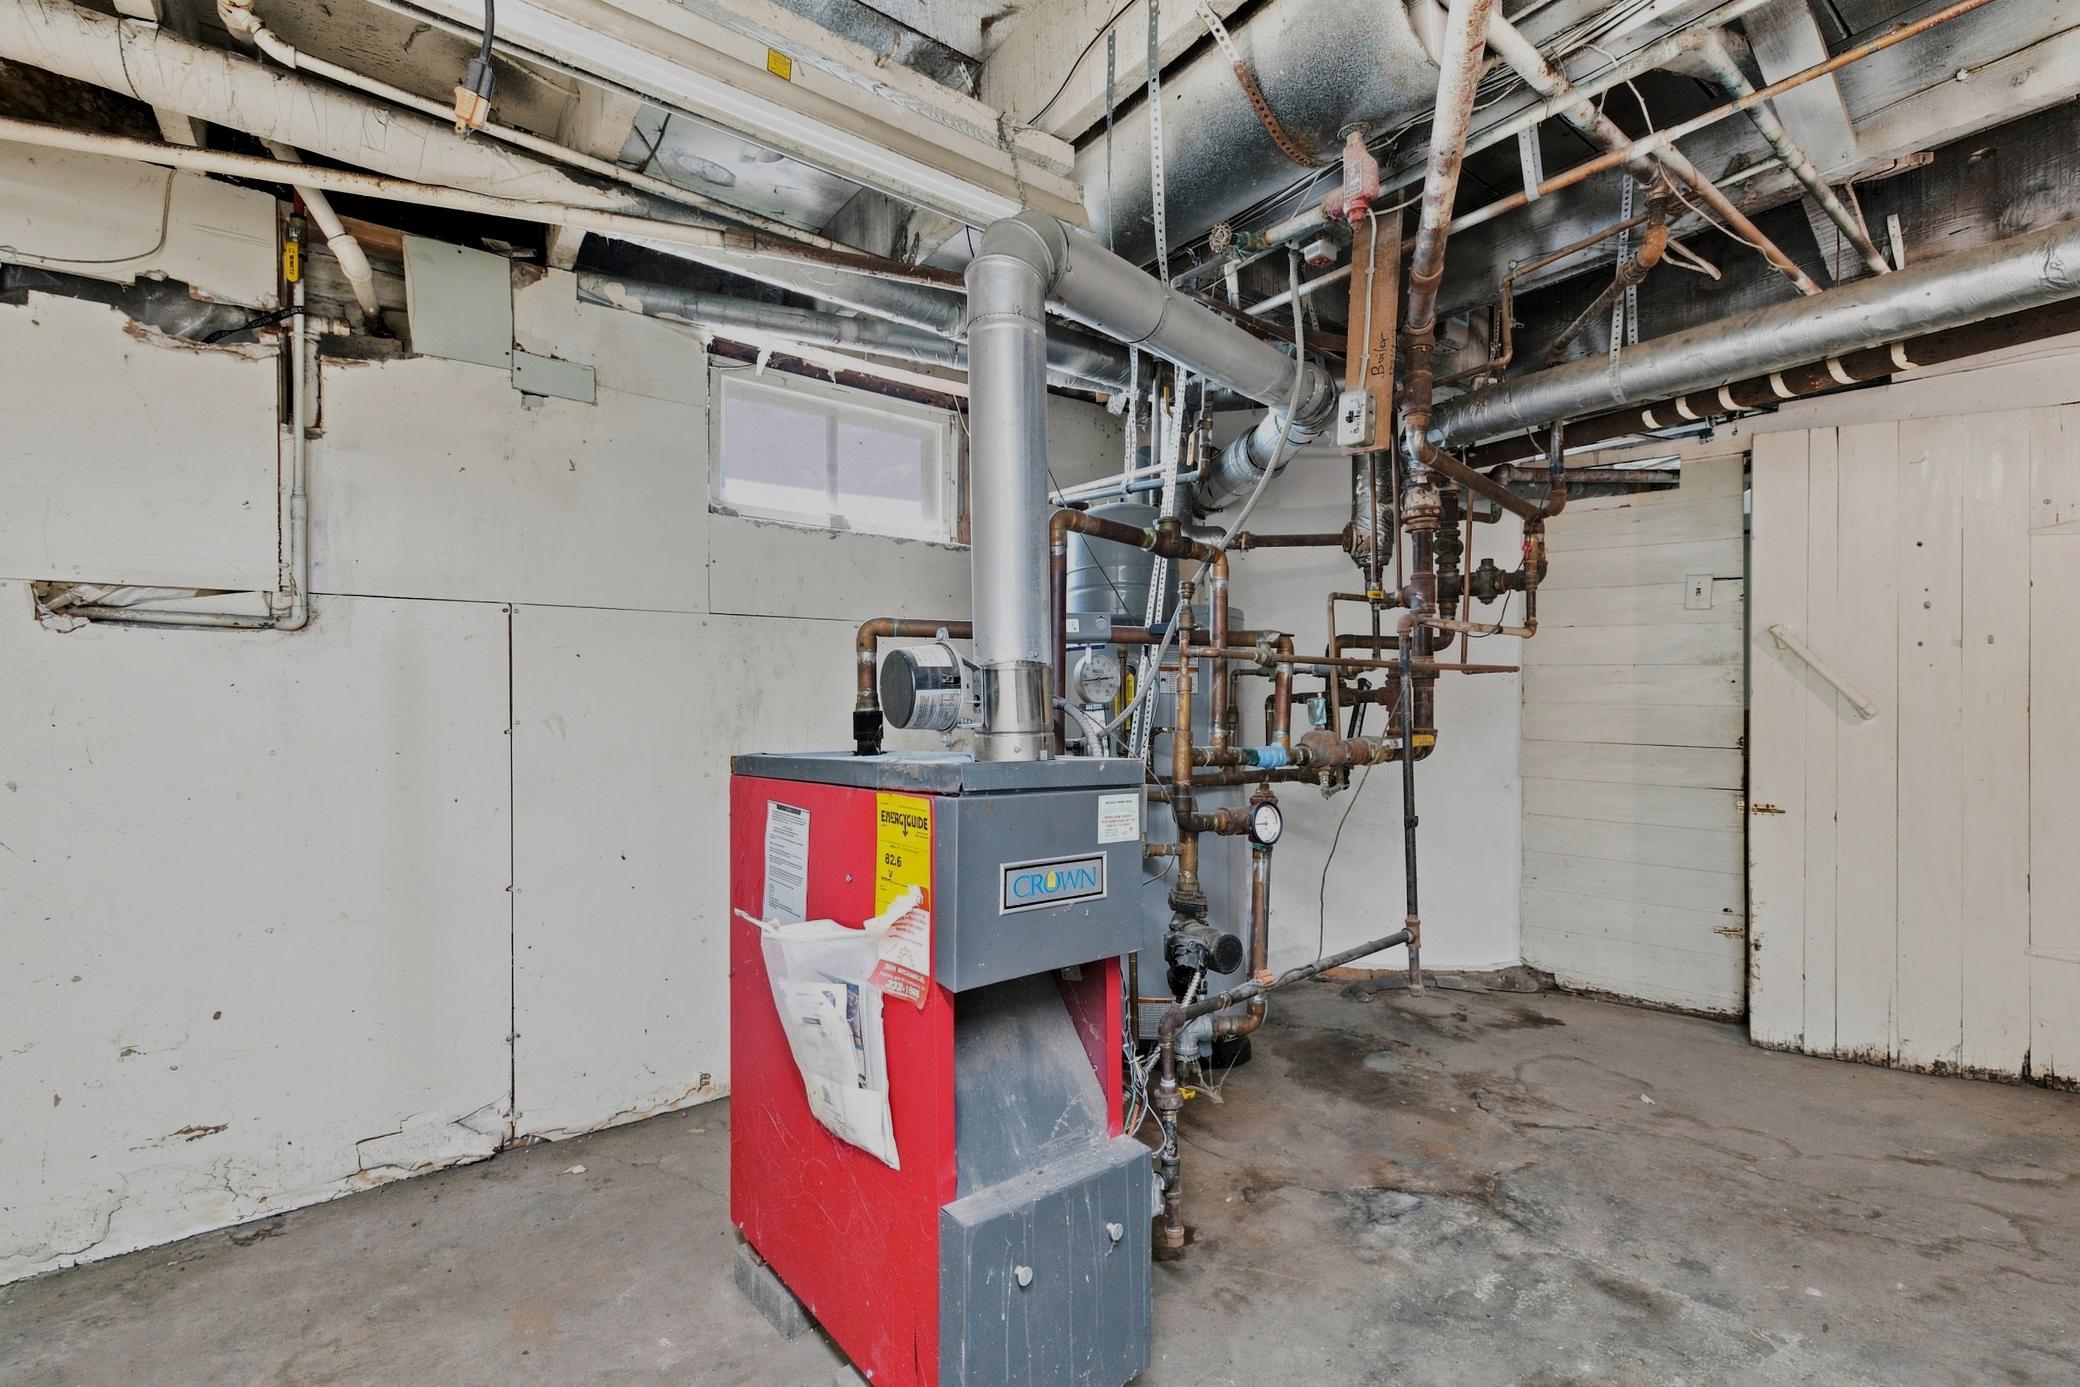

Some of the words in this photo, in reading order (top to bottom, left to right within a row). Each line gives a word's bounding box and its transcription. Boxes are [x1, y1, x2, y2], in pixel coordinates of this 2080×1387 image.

[1371, 332, 1389, 376] Boiler
[884, 852, 902, 868] 82.6
[1013, 866, 1097, 898] CROWN
